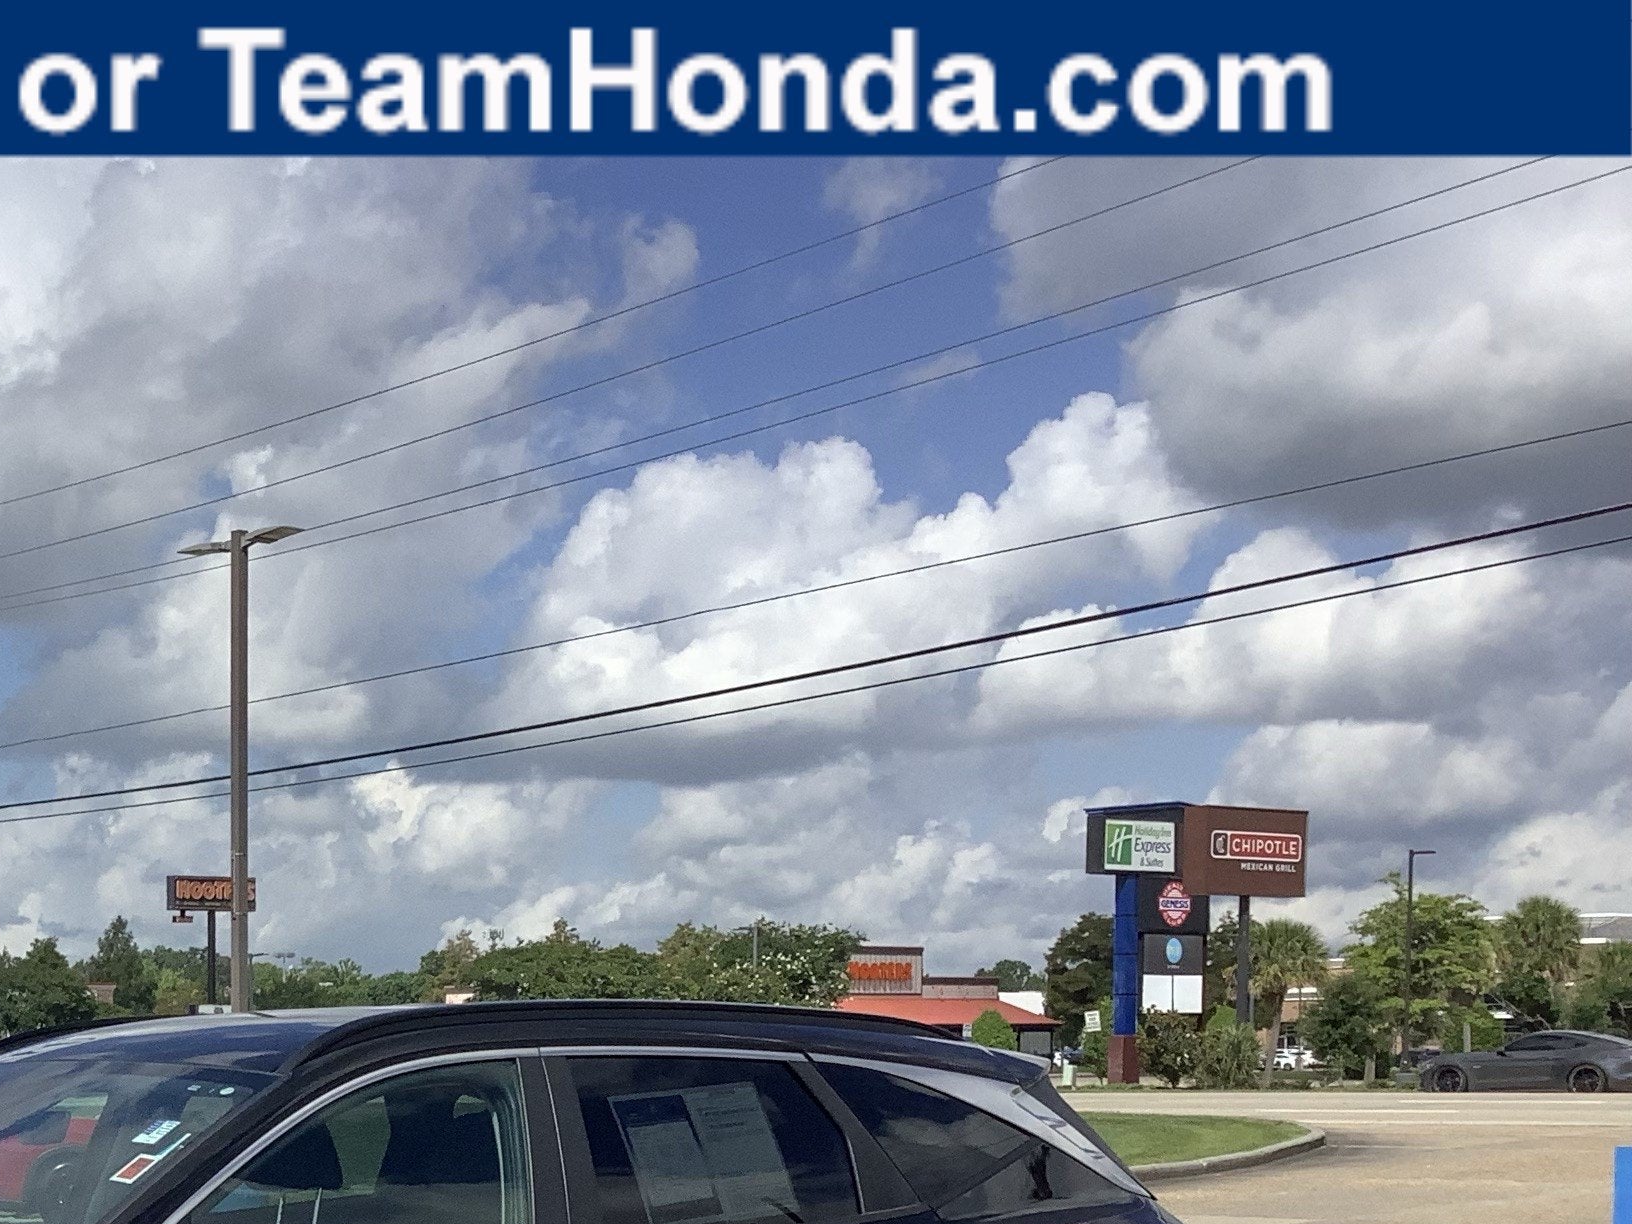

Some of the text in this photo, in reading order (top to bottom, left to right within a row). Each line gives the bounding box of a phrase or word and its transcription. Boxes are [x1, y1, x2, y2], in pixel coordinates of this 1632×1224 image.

[1134, 838, 1171, 856] Express
[1232, 838, 1298, 855] CHIPOTLE
[1240, 862, 1297, 873] MEXICAN GRILL
[176, 880, 255, 900] HOOTES
